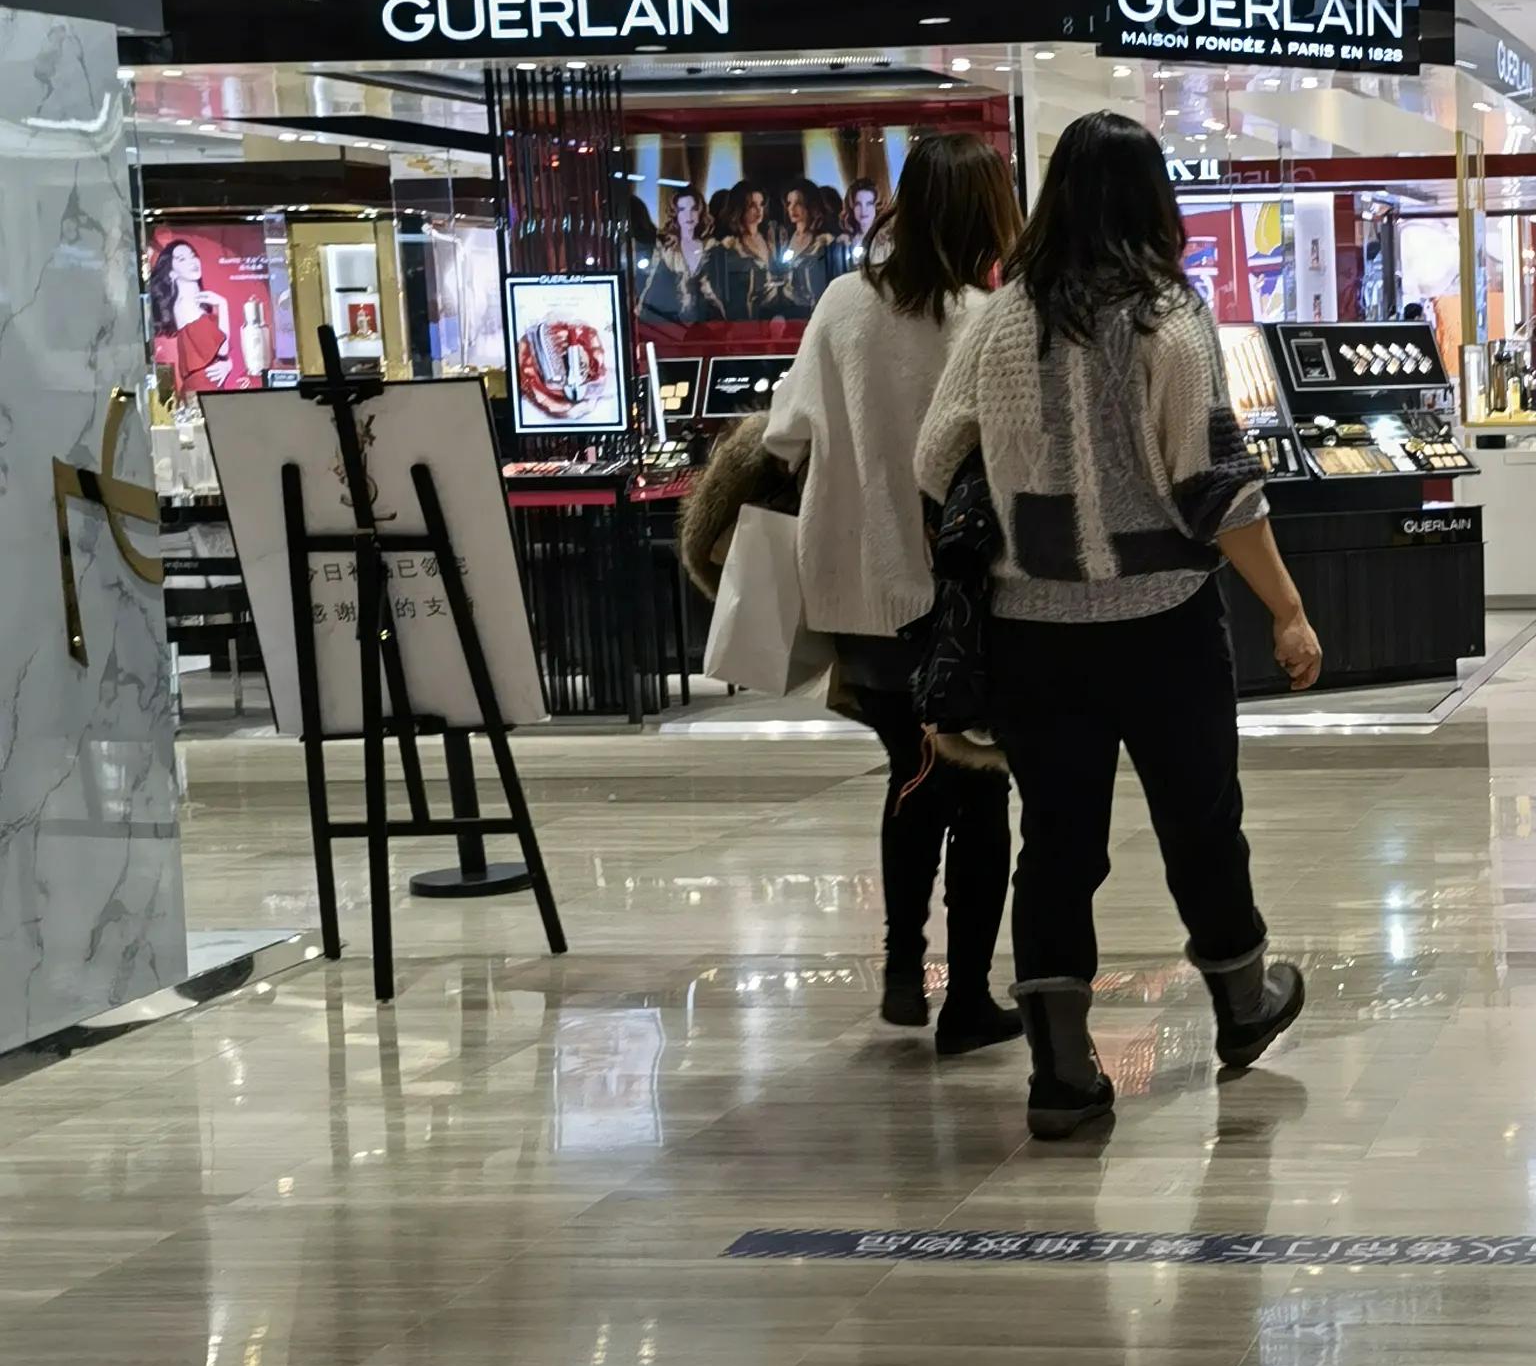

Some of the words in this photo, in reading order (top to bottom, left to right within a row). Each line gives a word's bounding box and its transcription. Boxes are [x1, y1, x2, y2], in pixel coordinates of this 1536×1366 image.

[1121, 30, 1189, 50] MAISON
[1195, 35, 1266, 55] FONDÉE
[1287, 41, 1335, 59] PARIS
[1340, 45, 1363, 60] EN
[1367, 47, 1404, 63] 1828
[1403, 517, 1472, 533] GUERLAIN
